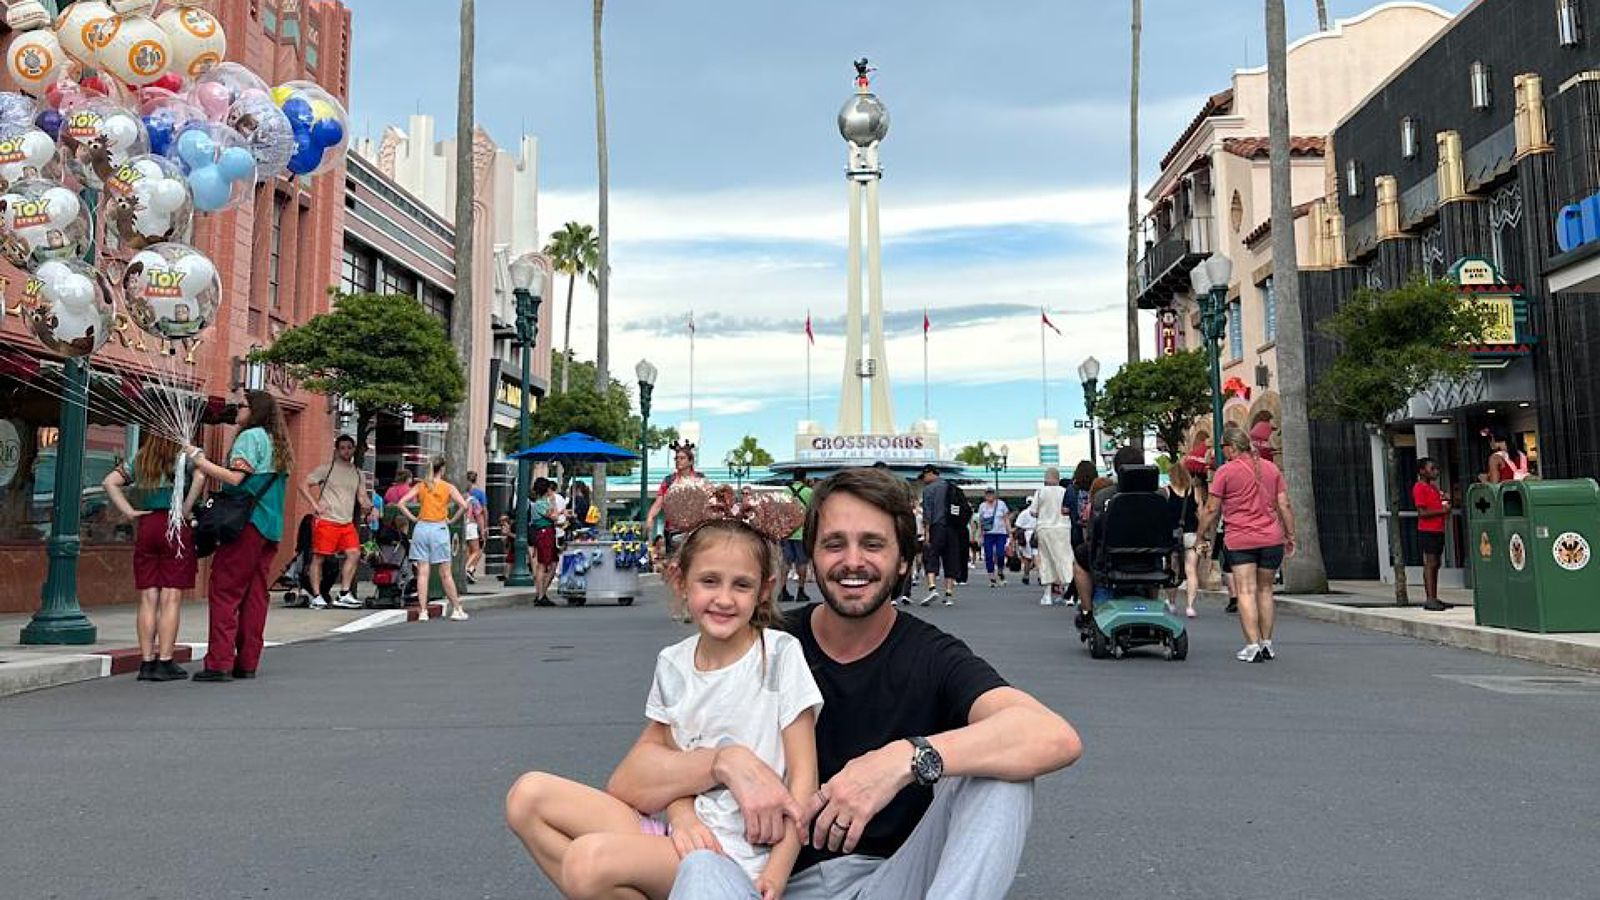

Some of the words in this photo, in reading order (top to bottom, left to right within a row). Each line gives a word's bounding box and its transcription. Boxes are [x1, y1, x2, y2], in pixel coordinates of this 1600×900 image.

[68, 113, 100, 128] TOY
[0, 136, 25, 154] OY
[12, 199, 51, 217] TOY
[147, 268, 186, 287] TOY
[812, 435, 924, 449] CROSSROADS
